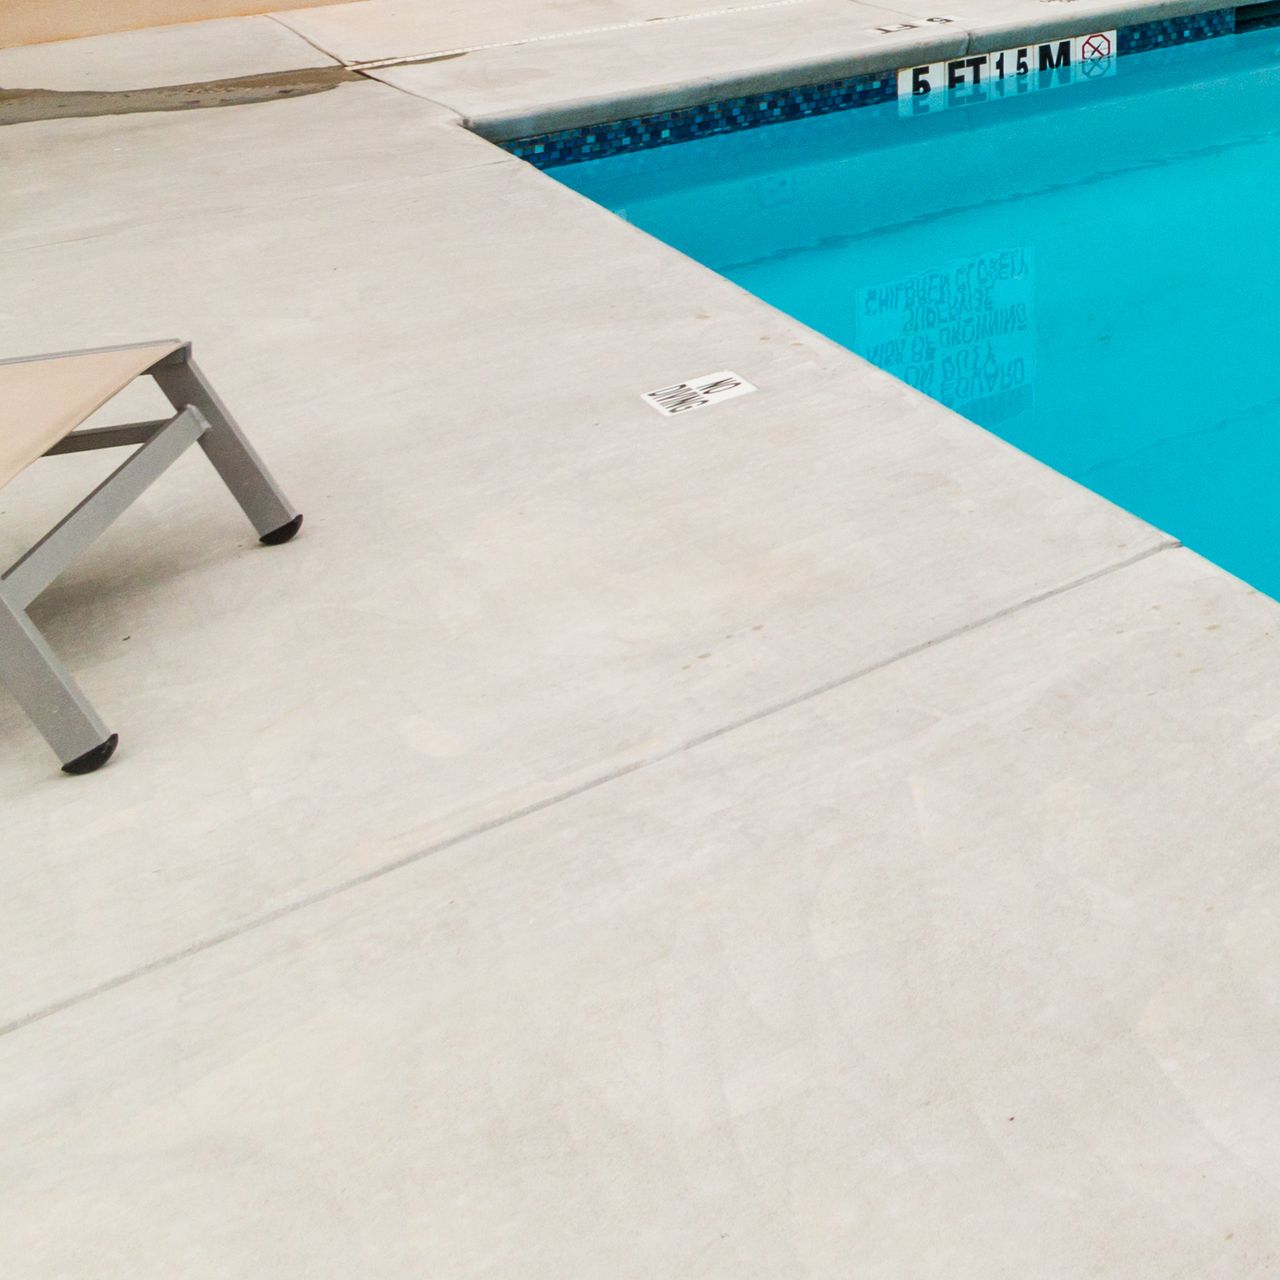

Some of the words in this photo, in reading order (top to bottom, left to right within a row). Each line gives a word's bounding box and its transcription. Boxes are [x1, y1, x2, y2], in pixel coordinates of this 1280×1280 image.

[912, 66, 931, 96] 5
[948, 56, 987, 89] FT
[1038, 40, 1071, 71] M
